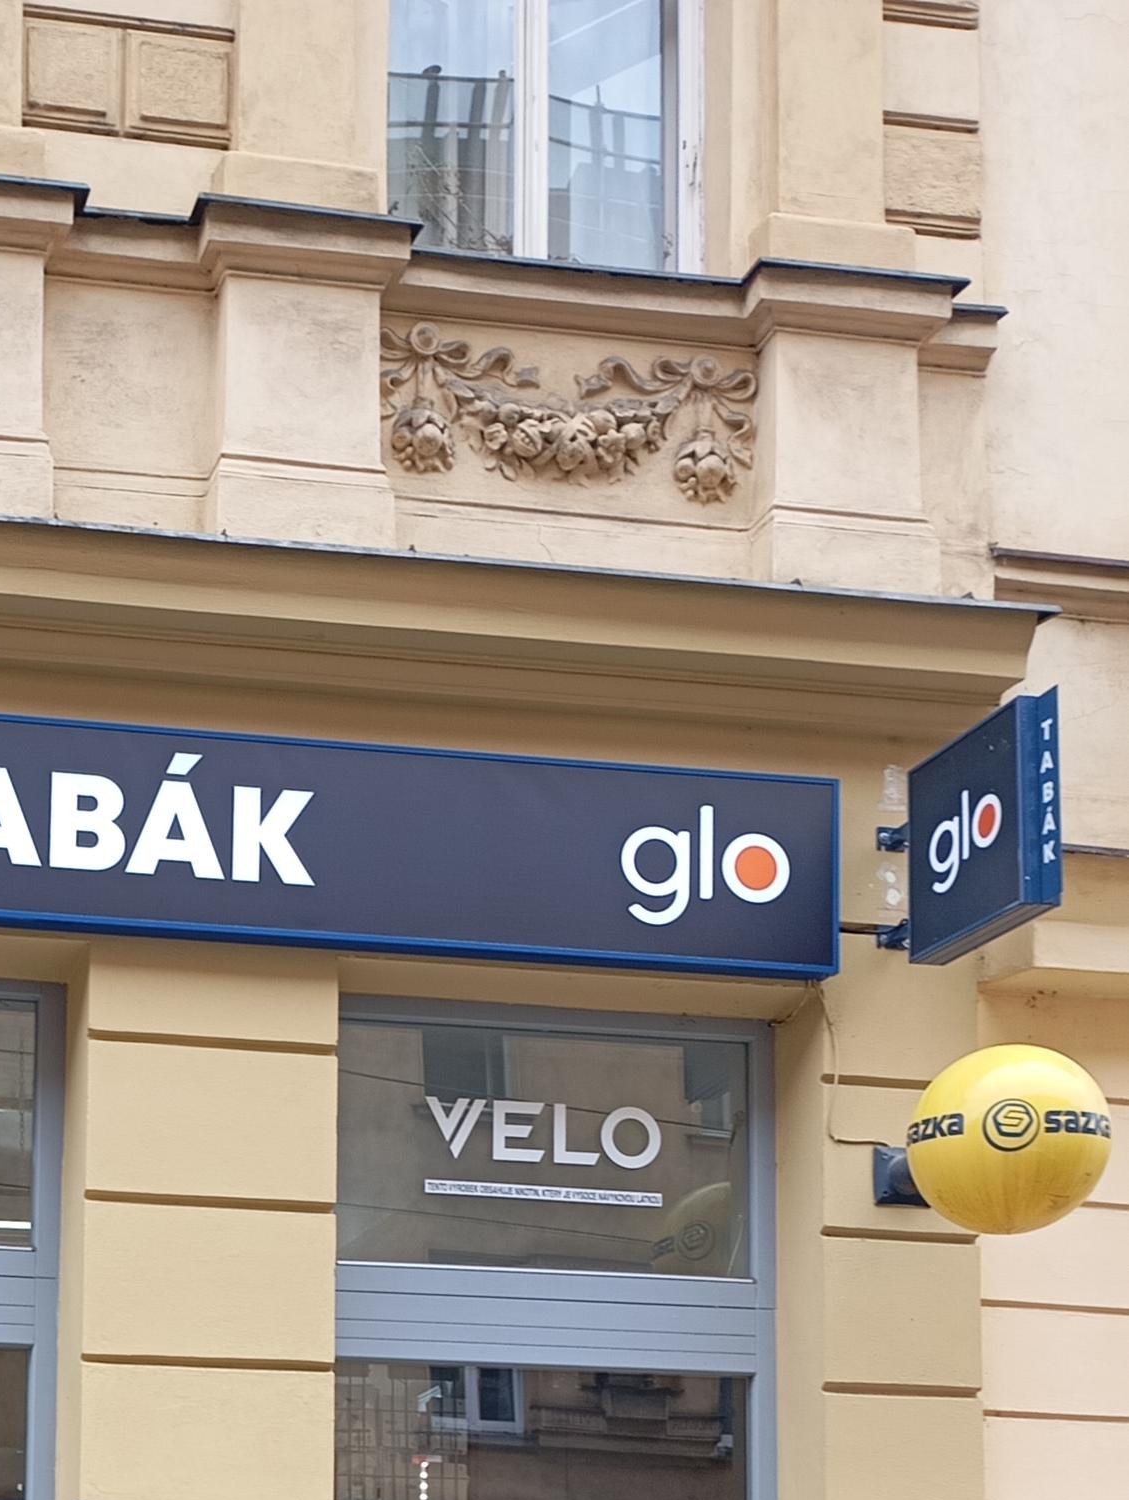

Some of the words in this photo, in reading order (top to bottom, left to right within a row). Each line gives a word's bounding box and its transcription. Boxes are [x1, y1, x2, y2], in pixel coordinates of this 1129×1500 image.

[929, 790, 1002, 894] glo
[1040, 718, 1057, 864] TABÁK
[621, 805, 791, 926] glo
[425, 1095, 662, 1169] VELO
